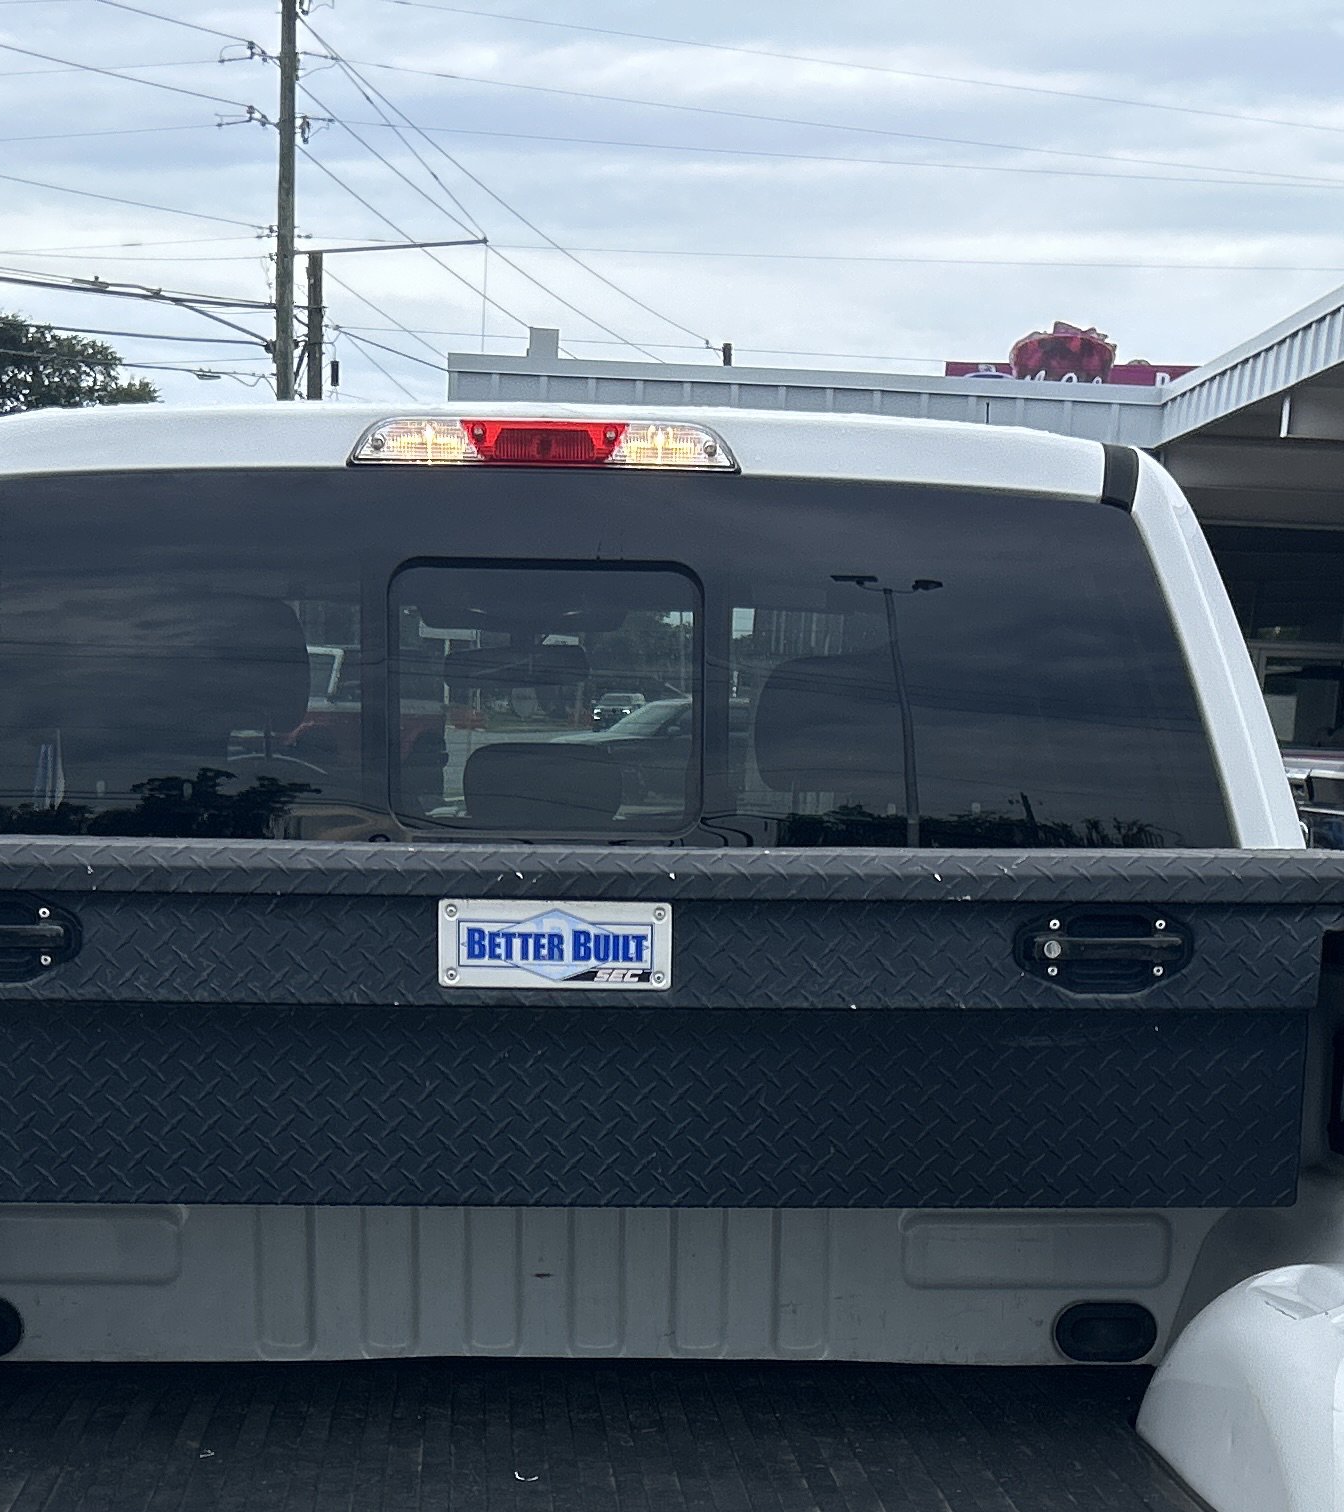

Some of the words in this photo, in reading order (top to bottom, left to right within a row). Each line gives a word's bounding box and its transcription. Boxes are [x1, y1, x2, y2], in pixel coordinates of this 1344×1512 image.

[466, 927, 564, 962] BETTER
[571, 928, 648, 963] BUILT
[593, 969, 643, 983] SEC
